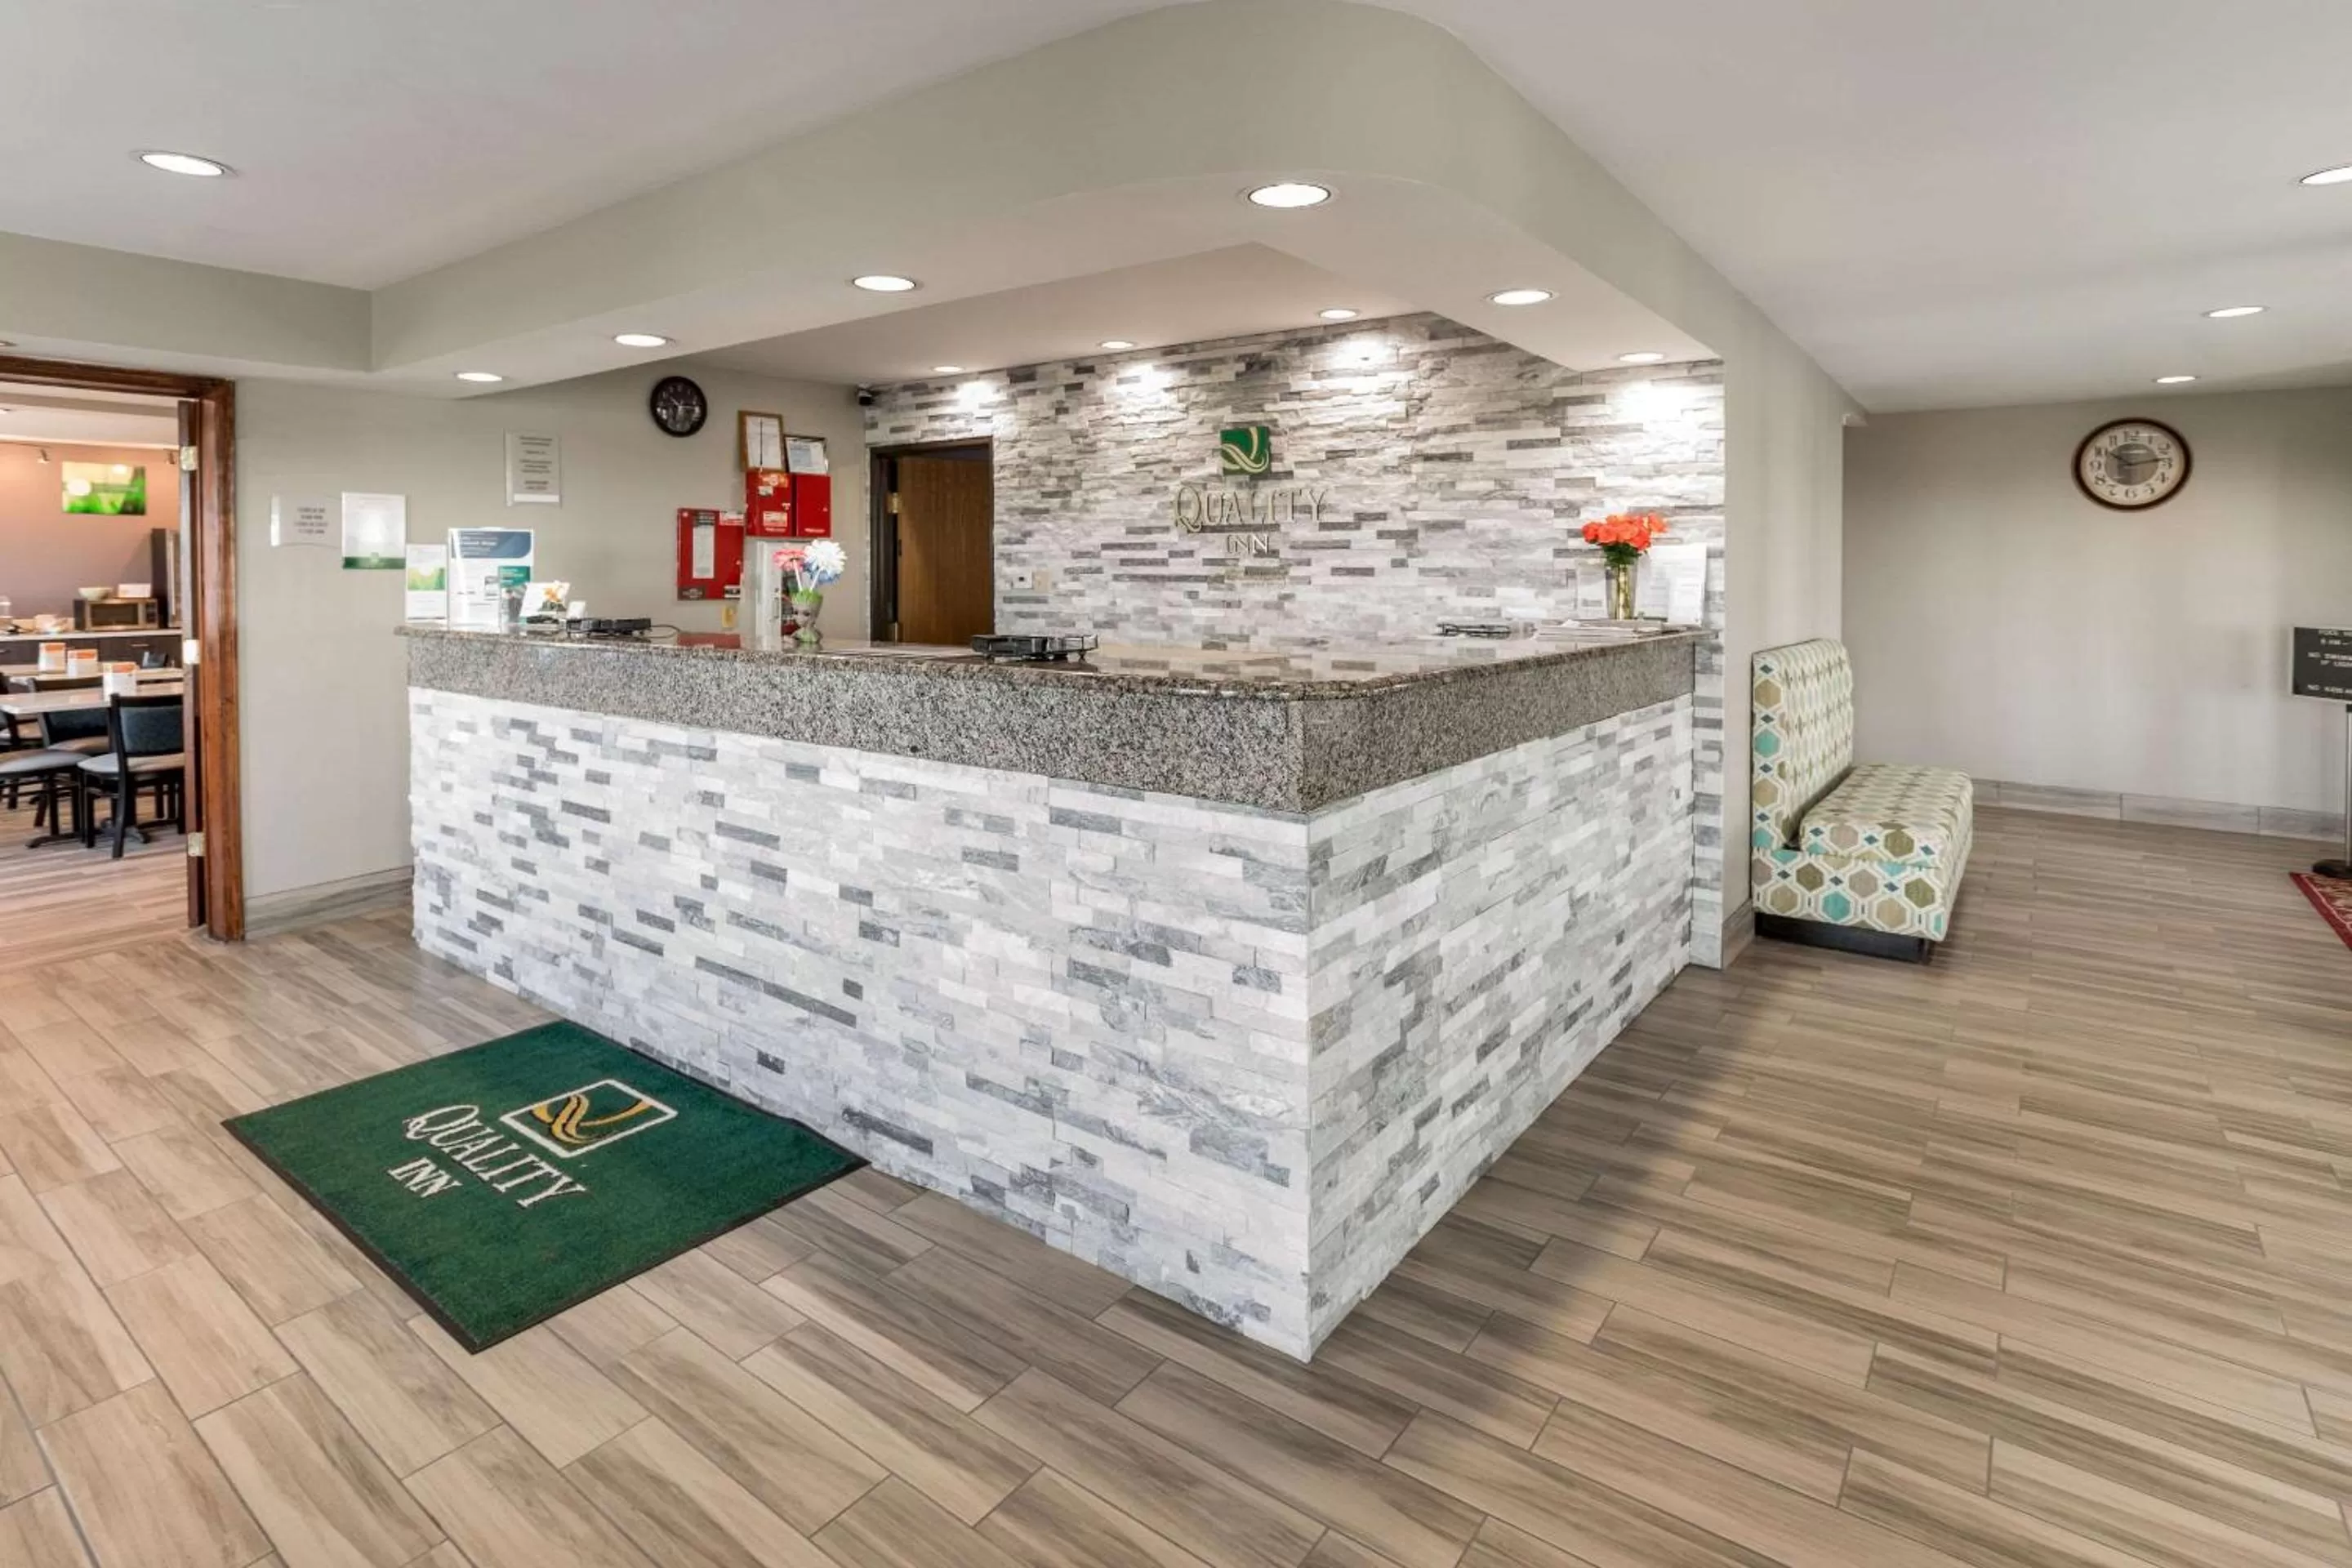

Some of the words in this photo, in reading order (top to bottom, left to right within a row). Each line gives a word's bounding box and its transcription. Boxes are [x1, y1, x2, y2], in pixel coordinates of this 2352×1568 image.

[1174, 484, 1329, 533] QUALITY
[1226, 533, 1271, 555] INN
[387, 1156, 464, 1198] INN
[402, 1104, 587, 1208] QUALITY
